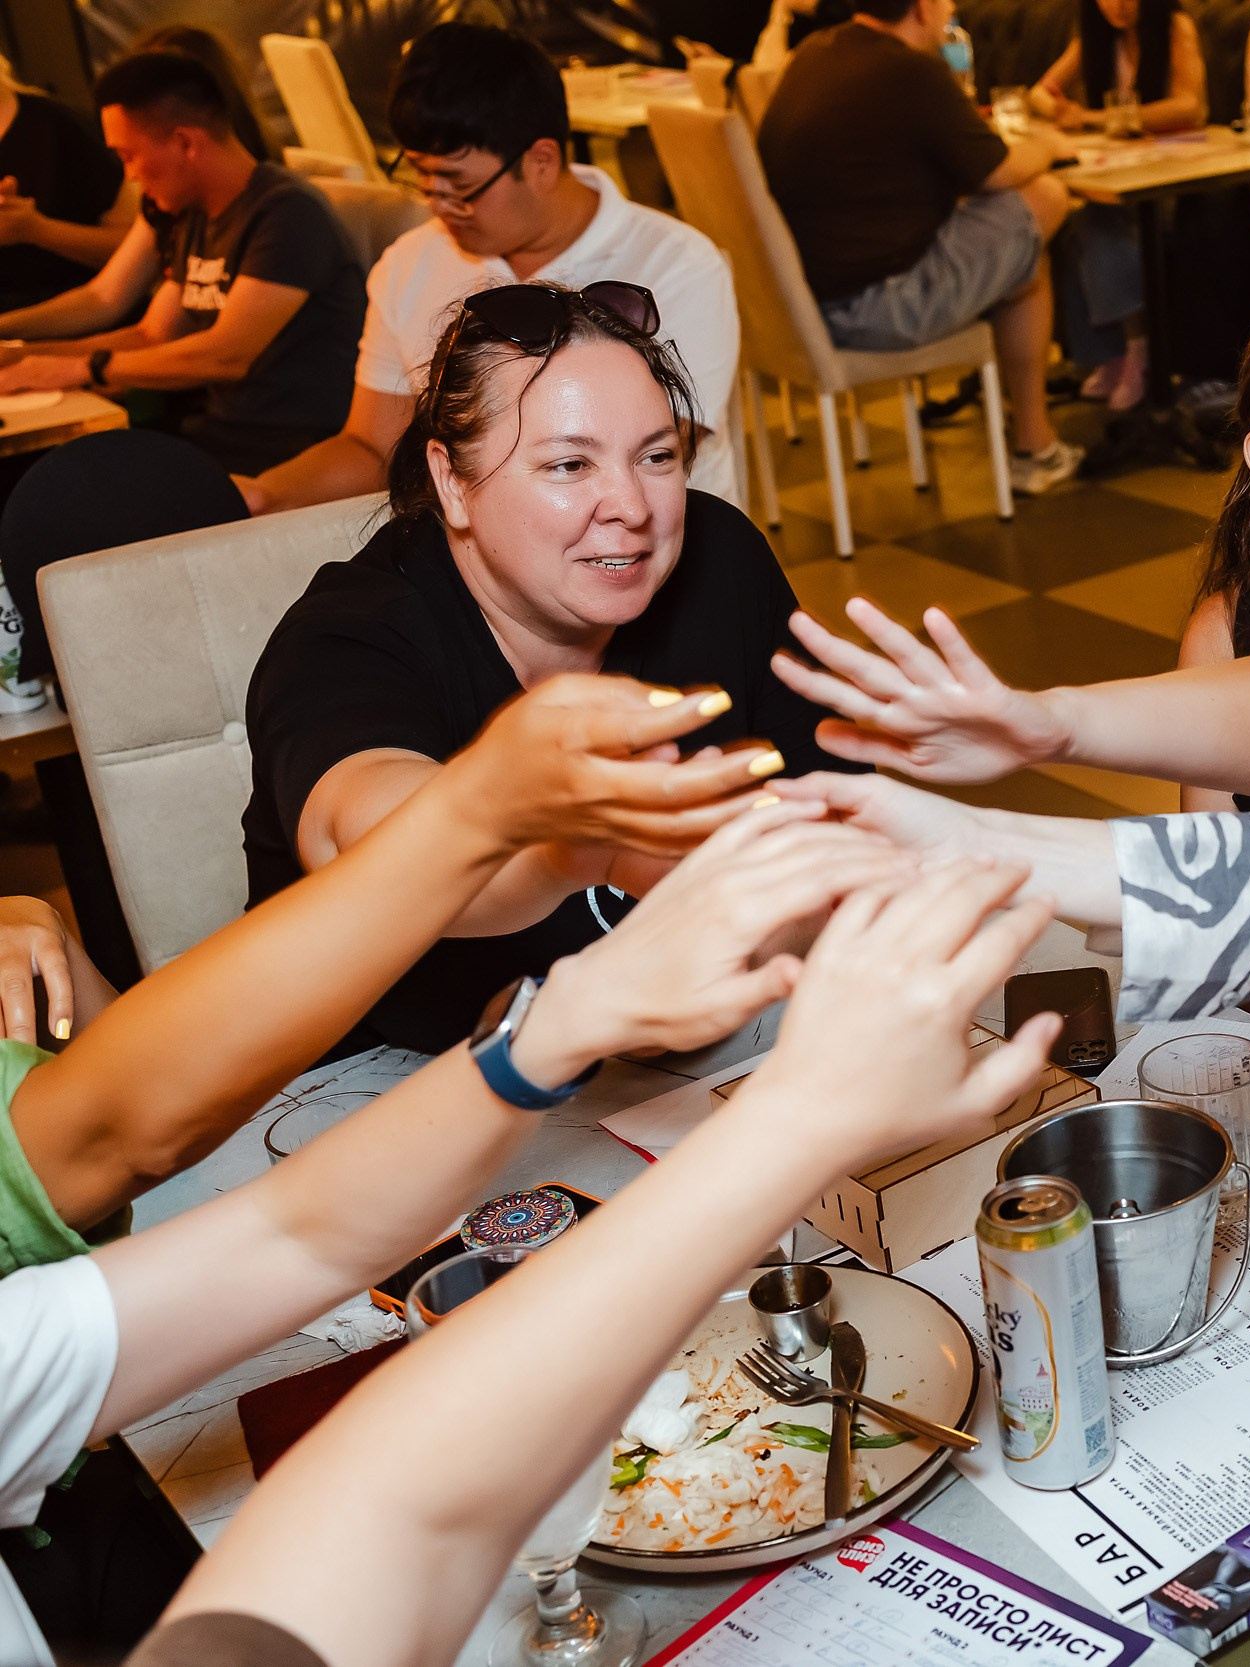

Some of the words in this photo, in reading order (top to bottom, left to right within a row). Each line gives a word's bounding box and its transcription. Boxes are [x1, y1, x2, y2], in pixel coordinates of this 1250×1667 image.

[1212, 1240, 1232, 1253] ЧАЙ
[1212, 1355, 1233, 1370] РОМ
[1121, 1388, 1151, 1411] ВОДКА
[1107, 1477, 1136, 1500] КАРТА
[1133, 1500, 1198, 1554] КОКТЕЙЛЬНАЯ
[799, 1560, 826, 1579] РАУНД
[1075, 1531, 1147, 1587] БАР
[869, 1568, 930, 1601] ДЛЯ
[890, 1551, 929, 1577] НЕ
[924, 1569, 1030, 1626] ПРОСТО
[1028, 1620, 1106, 1662] ЛИСТ
[724, 1620, 752, 1641] РАУНД
[930, 1628, 961, 1649] РАУНД
